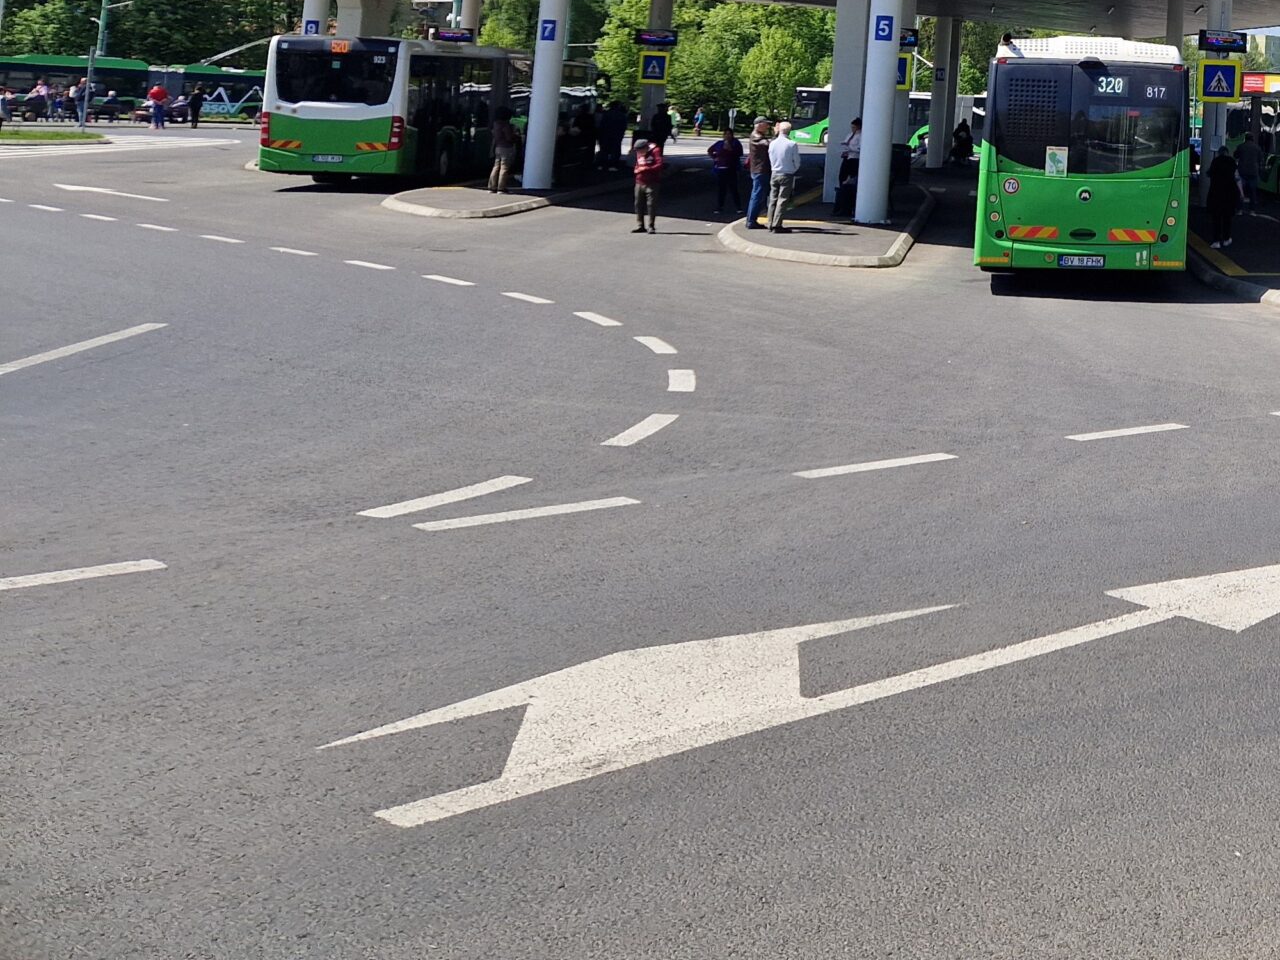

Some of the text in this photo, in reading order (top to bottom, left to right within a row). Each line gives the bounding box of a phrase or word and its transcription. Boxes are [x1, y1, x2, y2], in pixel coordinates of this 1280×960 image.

[307, 24, 316, 35] 9
[543, 24, 554, 37] 7
[878, 20, 890, 36] 5
[331, 41, 349, 53] 520
[1098, 76, 1123, 93] 320
[1146, 86, 1166, 98] 817
[1007, 182, 1017, 190] 70
